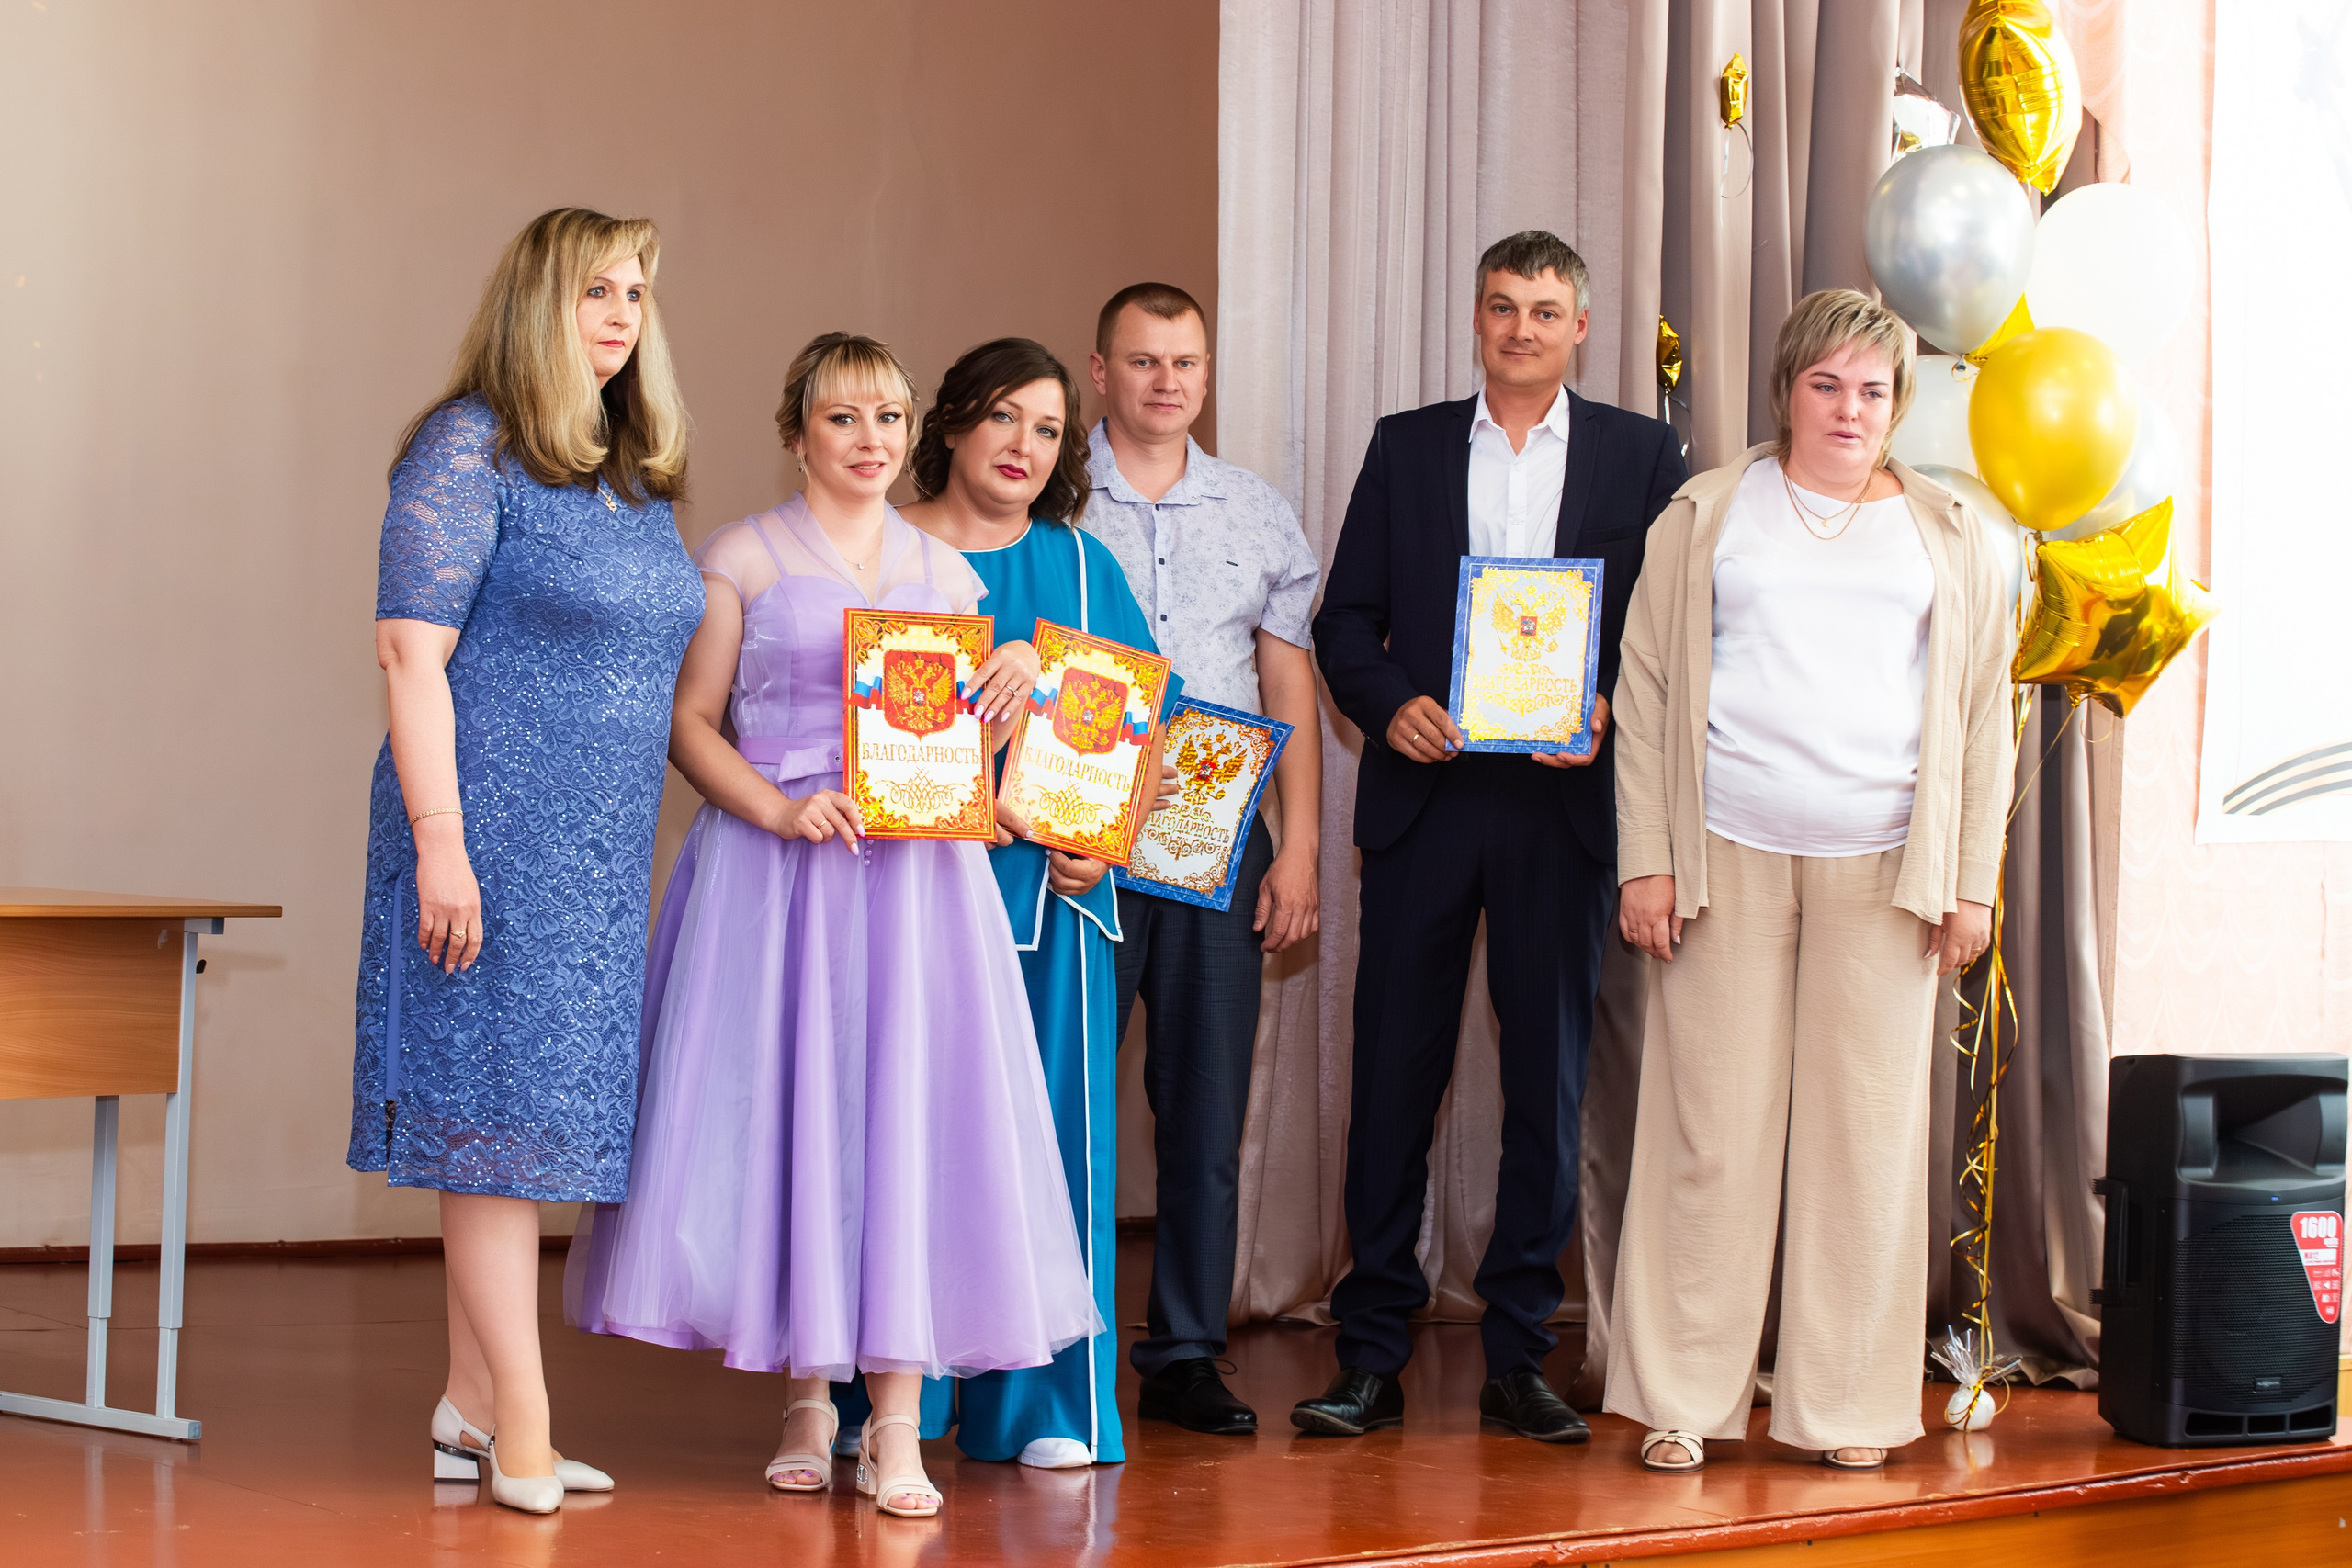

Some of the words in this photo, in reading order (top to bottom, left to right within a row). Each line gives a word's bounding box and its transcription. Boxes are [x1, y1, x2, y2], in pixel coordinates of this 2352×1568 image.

[1472, 673, 1577, 693] БЛАГОДАРНОСТЬ
[862, 742, 980, 764] БЛАГОДАРНОСТЬ
[1023, 746, 1131, 792] БЛАГОДАРНОСТЬ
[1147, 812, 1230, 844] ЛАГОДАРНОСТЬ
[2300, 1216, 2337, 1238] 1600
